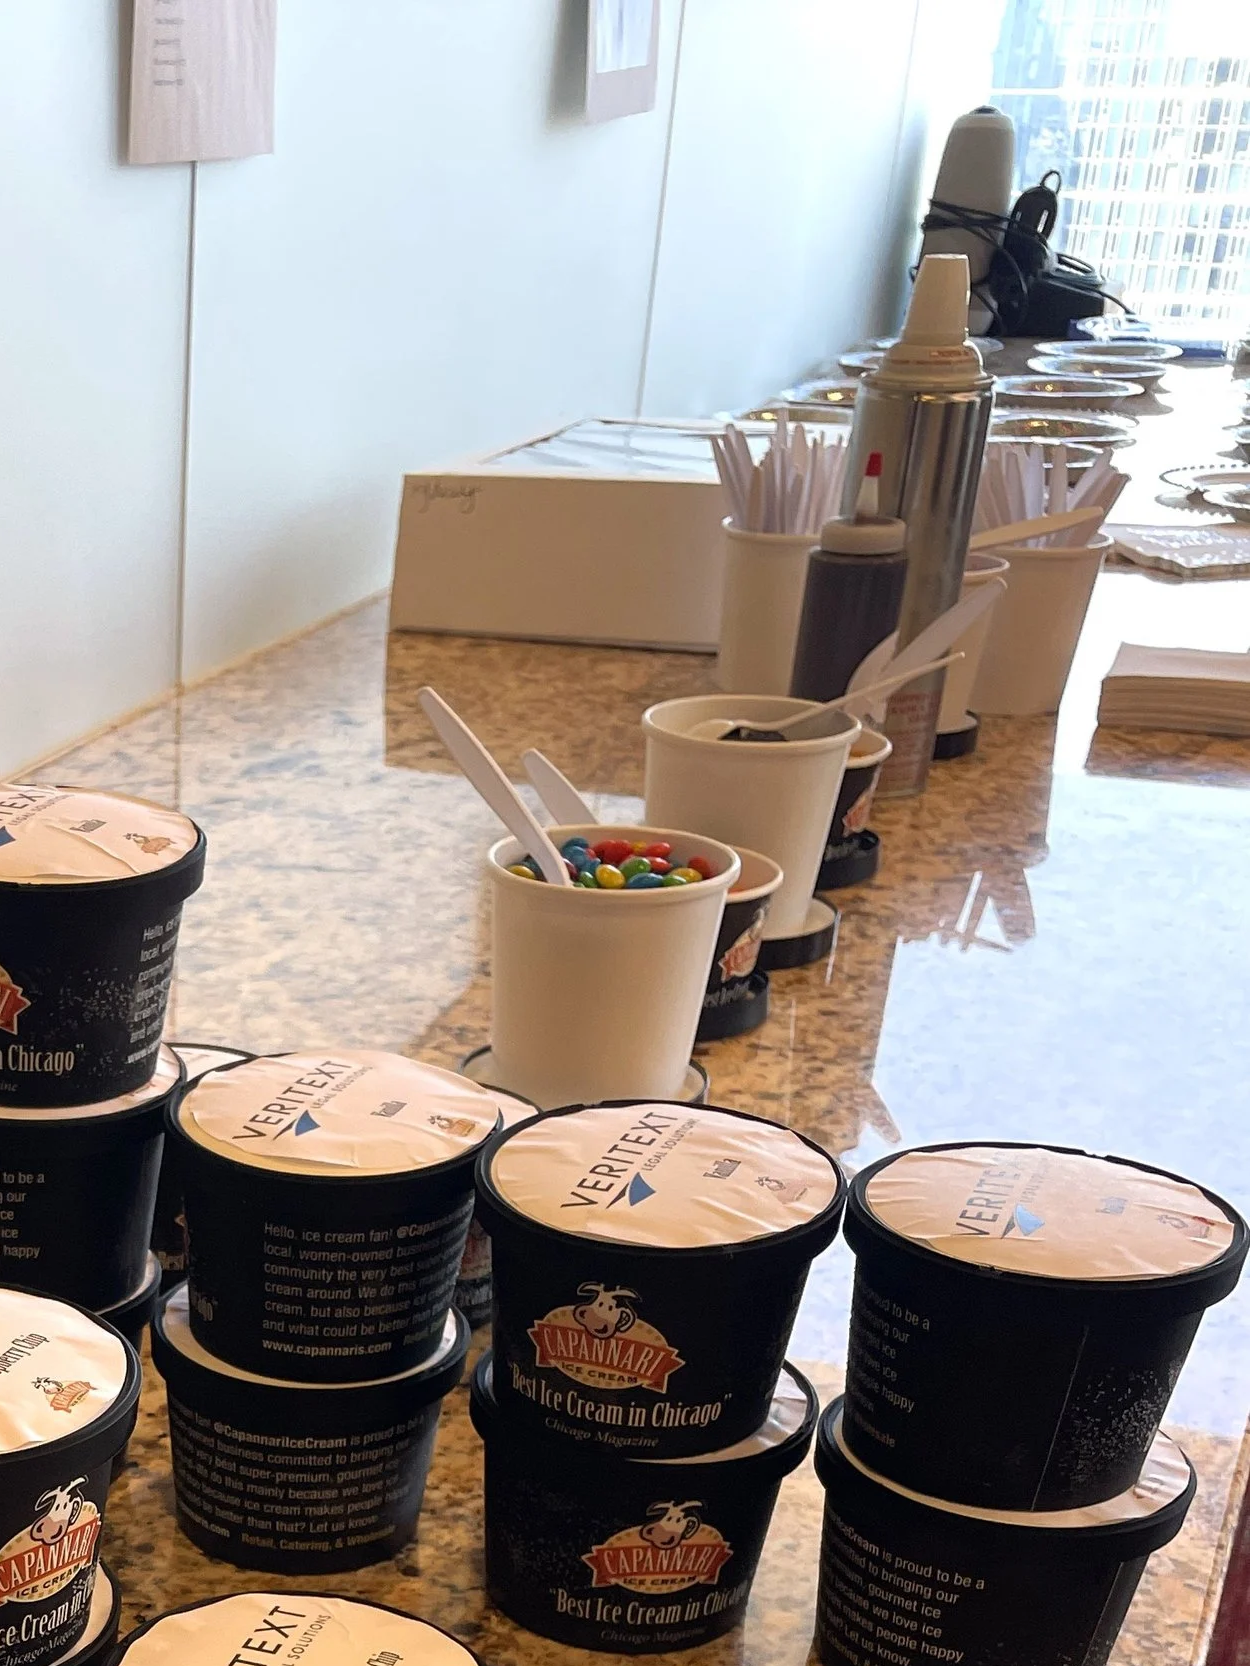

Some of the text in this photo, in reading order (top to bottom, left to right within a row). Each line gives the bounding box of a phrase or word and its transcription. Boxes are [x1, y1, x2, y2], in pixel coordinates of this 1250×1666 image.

[232, 1060, 352, 1140] VERITEXT
[560, 1112, 679, 1209] VERITEXT
[642, 1151, 668, 1172] LEGAL
[3, 1172, 15, 1183] to
[19, 1172, 34, 1184] be
[7, 1192, 27, 1203] our
[302, 1230, 365, 1243] ice cream
[3, 1245, 40, 1259] happy
[264, 1262, 333, 1284] community
[542, 1326, 667, 1376] CAPANNARI
[561, 1363, 638, 1383] ICE CREAM
[540, 1377, 561, 1412] Ice
[567, 1390, 622, 1426] Cream
[628, 1401, 646, 1428] in
[603, 1546, 721, 1574] CAPANNARI
[895, 1557, 971, 1587] proud to be
[16, 1584, 39, 1599] ICE
[623, 1575, 697, 1586] ICE CREAM
[882, 1569, 960, 1605] bringing our
[596, 1598, 622, 1624] Ice
[627, 1602, 681, 1625] Cream
[684, 1598, 701, 1621] in
[868, 1583, 942, 1619] gourmet ice
[22, 1603, 68, 1642] Cream
[70, 1589, 85, 1616] in
[893, 1612, 942, 1638] love ice
[287, 1613, 332, 1661] SOLUTIONS
[876, 1626, 964, 1664] people happy
